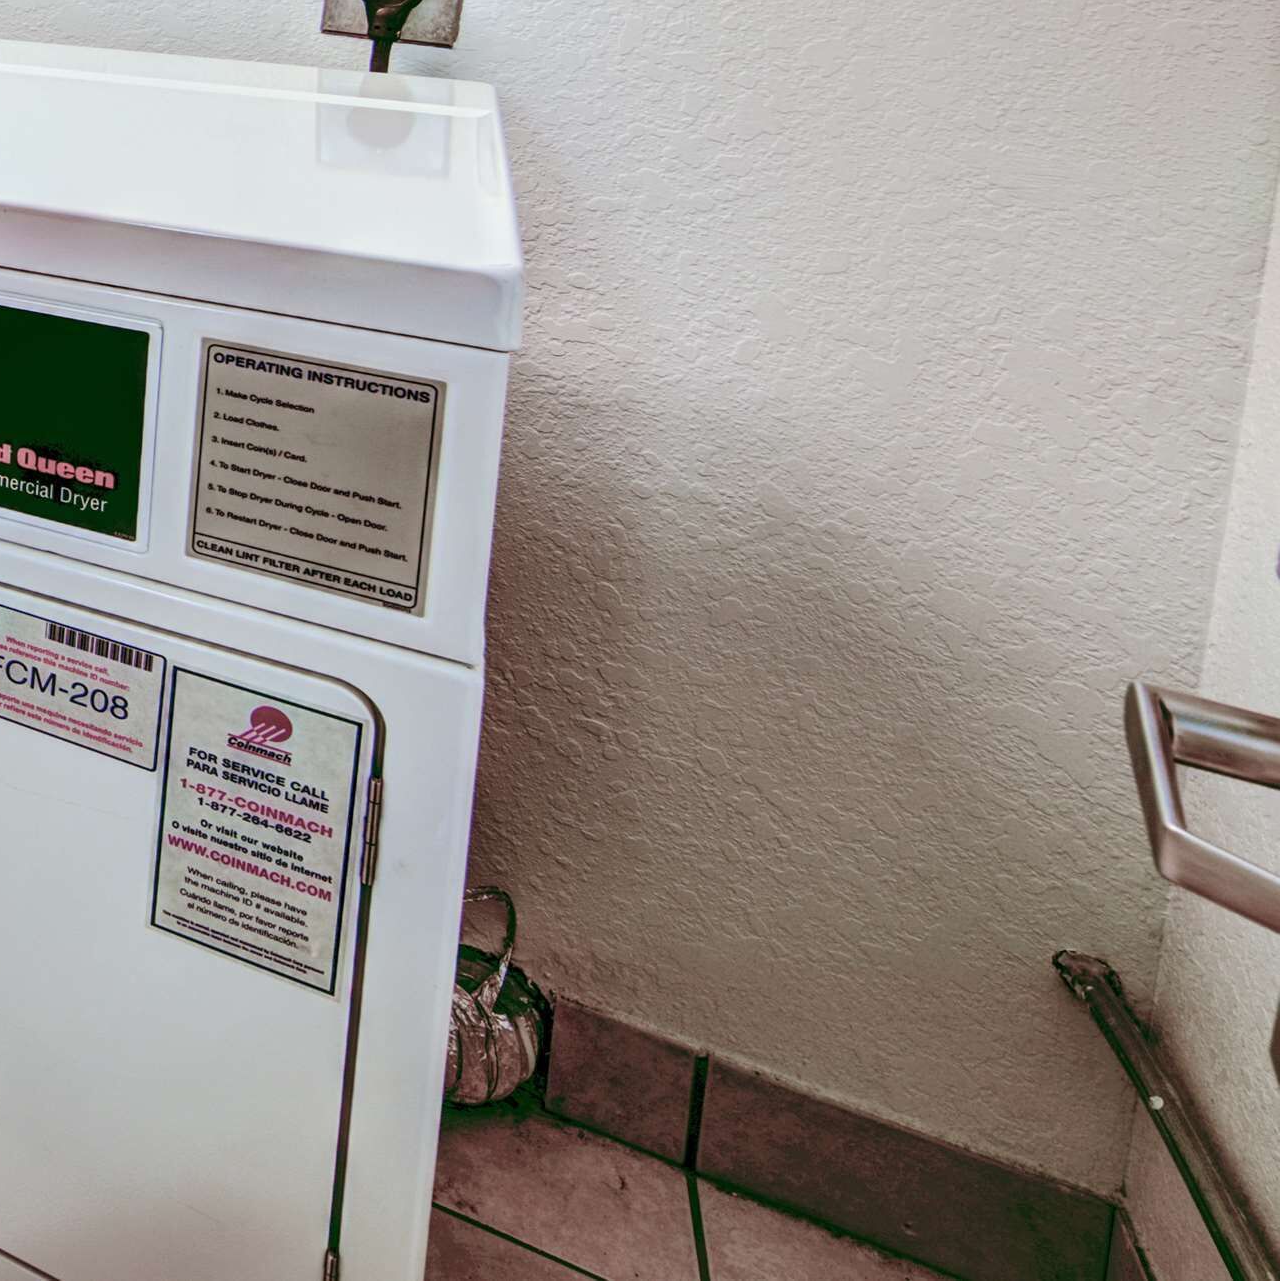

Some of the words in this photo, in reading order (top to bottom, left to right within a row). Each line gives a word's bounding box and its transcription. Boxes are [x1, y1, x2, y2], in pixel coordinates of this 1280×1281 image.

[213, 352, 303, 378] OPERATING
[307, 370, 430, 402] INSTRUCTIONS
[216, 387, 223, 395] 1.
[224, 389, 248, 399] Make
[249, 393, 273, 405] Cycle
[274, 399, 314, 413] Selection
[213, 411, 221, 419] 2.
[222, 413, 244, 423] Load
[245, 418, 279, 431] Clothes.
[17, 447, 115, 489] Queen
[211, 435, 219, 443] 3.
[220, 437, 245, 448] Insert
[245, 442, 277, 456] Coin(s)
[283, 451, 307, 462] Card.
[60, 486, 108, 512] Dryer
[207, 482, 214, 490] 5.
[216, 484, 227, 493] To
[228, 487, 248, 498] Stop
[249, 492, 273, 503] Dryer
[274, 498, 303, 512] During
[304, 505, 329, 517] Cycle
[336, 513, 362, 525] Open
[363, 519, 387, 531] Door.
[218, 460, 229, 469] To
[230, 463, 251, 474] Start
[252, 468, 276, 479] Dryer
[282, 475, 308, 487] Close
[309, 481, 331, 492] Door
[332, 488, 350, 497] and
[351, 491, 375, 503] Push
[376, 496, 401, 509] Start.
[214, 508, 225, 517] To
[226, 511, 257, 524] Restart
[258, 519, 282, 530] Dryer
[289, 526, 314, 539] Close
[315, 533, 337, 544] Door
[338, 540, 357, 549] and
[357, 543, 381, 555] Push
[383, 549, 407, 561] Start.
[197, 539, 233, 556] CLEAN
[235, 549, 260, 562] LINT
[262, 556, 300, 573] FILTER
[302, 567, 341, 583] AFTER
[343, 577, 376, 592] EACH
[379, 586, 413, 602] LOAD
[188, 747, 217, 764] FOR
[221, 758, 285, 786] SERVICE
[289, 781, 329, 801] CALL
[227, 736, 292, 763] Coinmach
[180, 778, 332, 837] 1-877-COINMACH
[186, 758, 218, 776] PARA
[221, 770, 281, 796] SERVICIO
[284, 791, 329, 813] LLAME
[197, 797, 311, 842] 1-877-264-6622
[200, 819, 212, 829] Or
[215, 825, 237, 838] visit
[240, 835, 258, 845] our
[261, 842, 303, 861] website
[167, 835, 331, 900] WWW.COINMACH.COM
[171, 820, 179, 829] O
[181, 825, 208, 839] visite
[209, 835, 248, 853] nuestro
[250, 850, 272, 862] sitio
[274, 858, 288, 868] de
[290, 862, 332, 883] internet
[184, 876, 199, 887] the
[200, 883, 240, 901] machine
[242, 897, 253, 906] ID
[263, 907, 307, 927] available.
[187, 866, 213, 881] When
[215, 878, 248, 895] calling,
[250, 891, 282, 906] please
[283, 902, 307, 915] have
